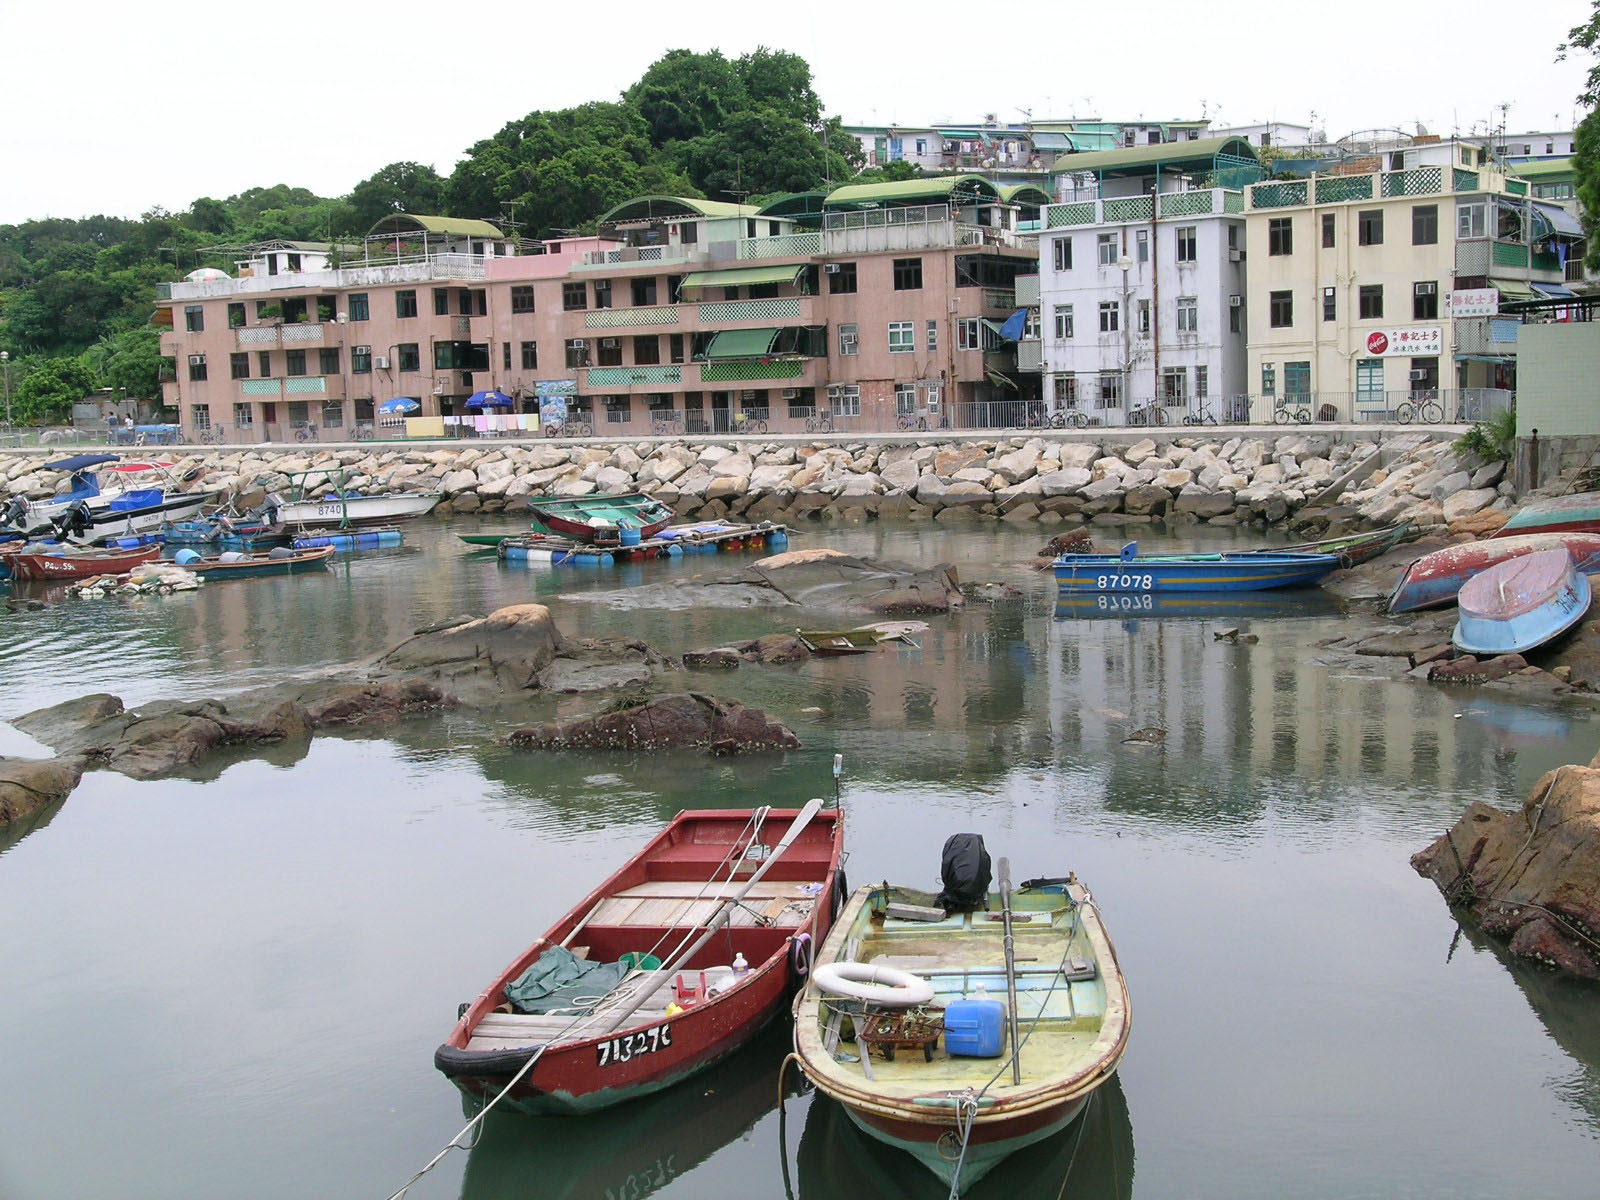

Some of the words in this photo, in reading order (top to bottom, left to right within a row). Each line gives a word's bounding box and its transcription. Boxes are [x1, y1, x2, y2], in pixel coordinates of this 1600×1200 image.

[1400, 330, 1439, 342] 勝記士多
[1097, 574, 1153, 590] 87078
